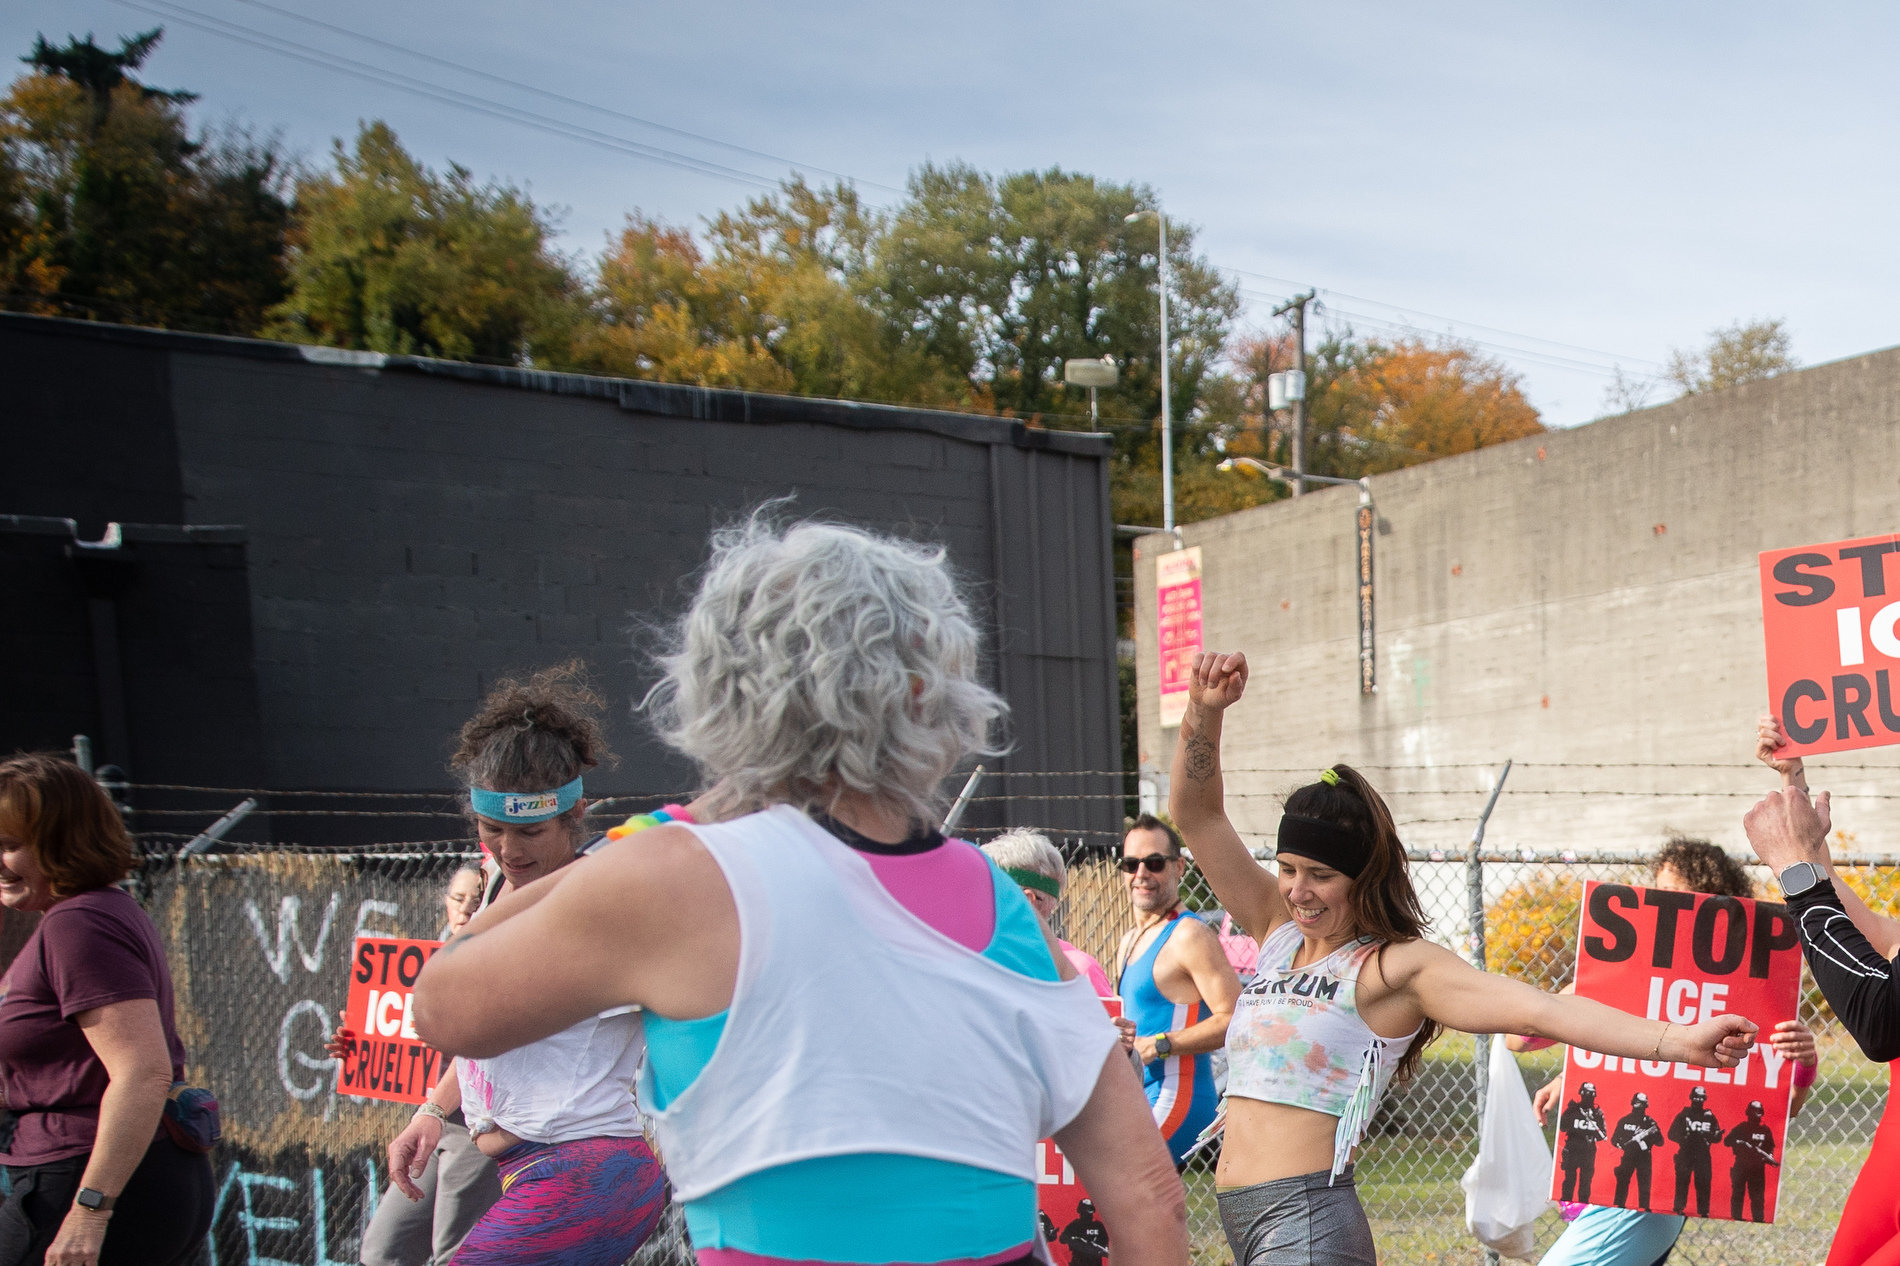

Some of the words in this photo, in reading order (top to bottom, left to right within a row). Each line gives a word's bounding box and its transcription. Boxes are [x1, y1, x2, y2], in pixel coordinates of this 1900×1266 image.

[509, 795, 557, 813] jezzica
[1584, 884, 1799, 979] STOP
[356, 943, 440, 987] STO
[1287, 998, 1313, 1008] PROUD
[1646, 976, 1729, 1025] ICE
[343, 1039, 436, 1098] CRUELTY
[1574, 1119, 1597, 1130] ICE
